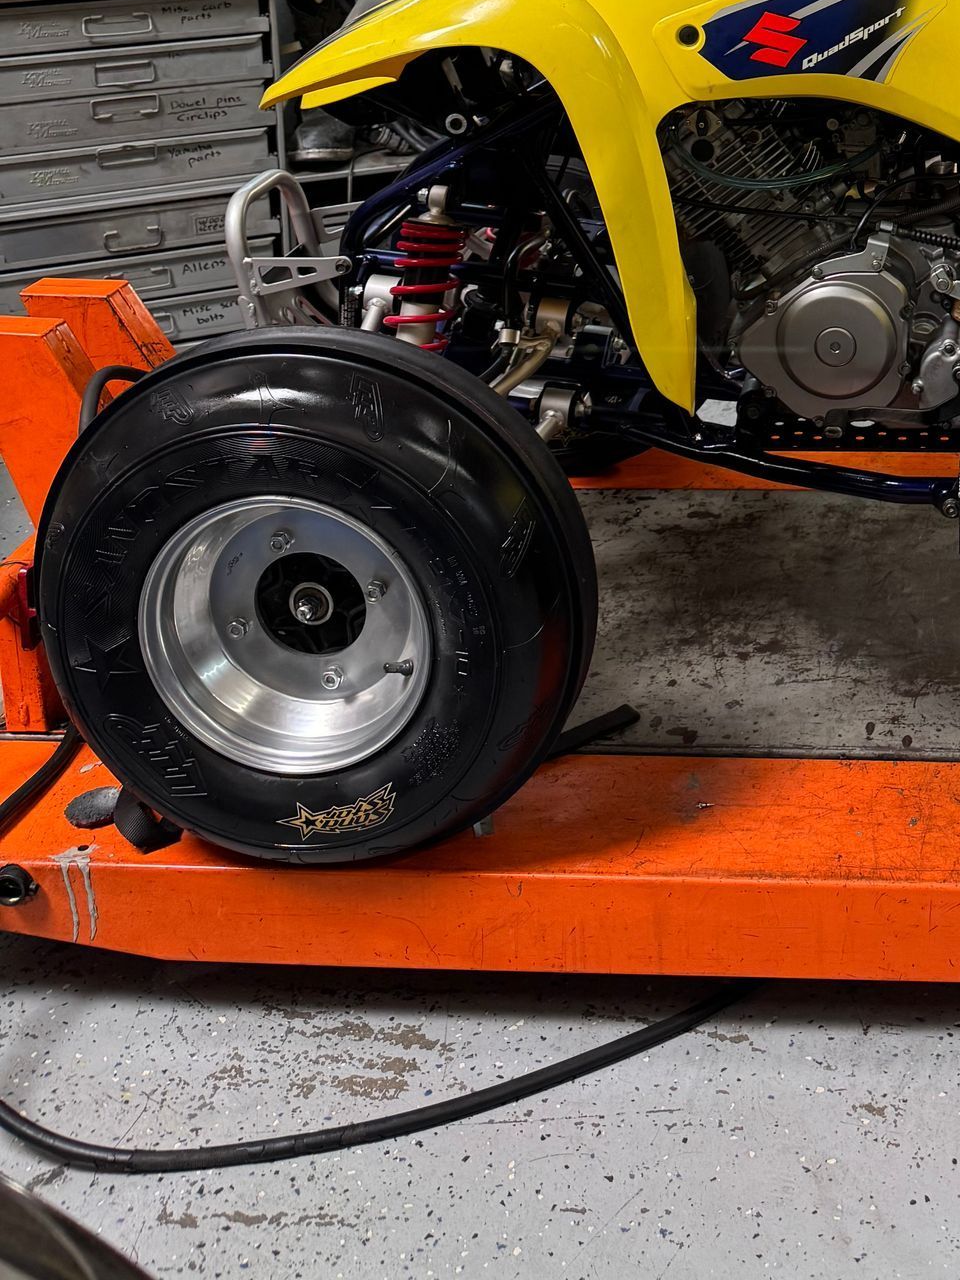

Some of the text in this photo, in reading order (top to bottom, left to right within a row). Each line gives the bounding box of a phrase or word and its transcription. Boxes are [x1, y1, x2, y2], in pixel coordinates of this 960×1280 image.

[162, 6, 189, 15] Misc
[801, 5, 907, 71] QuadSport
[171, 96, 242, 111] Dowel pins
[177, 109, 228, 122] Circlips
[168, 144, 213, 158] Yamaha
[188, 150, 222, 169] parts
[182, 260, 227, 276] Allens
[182, 304, 213, 317] Misc
[196, 313, 226, 325] bolts
